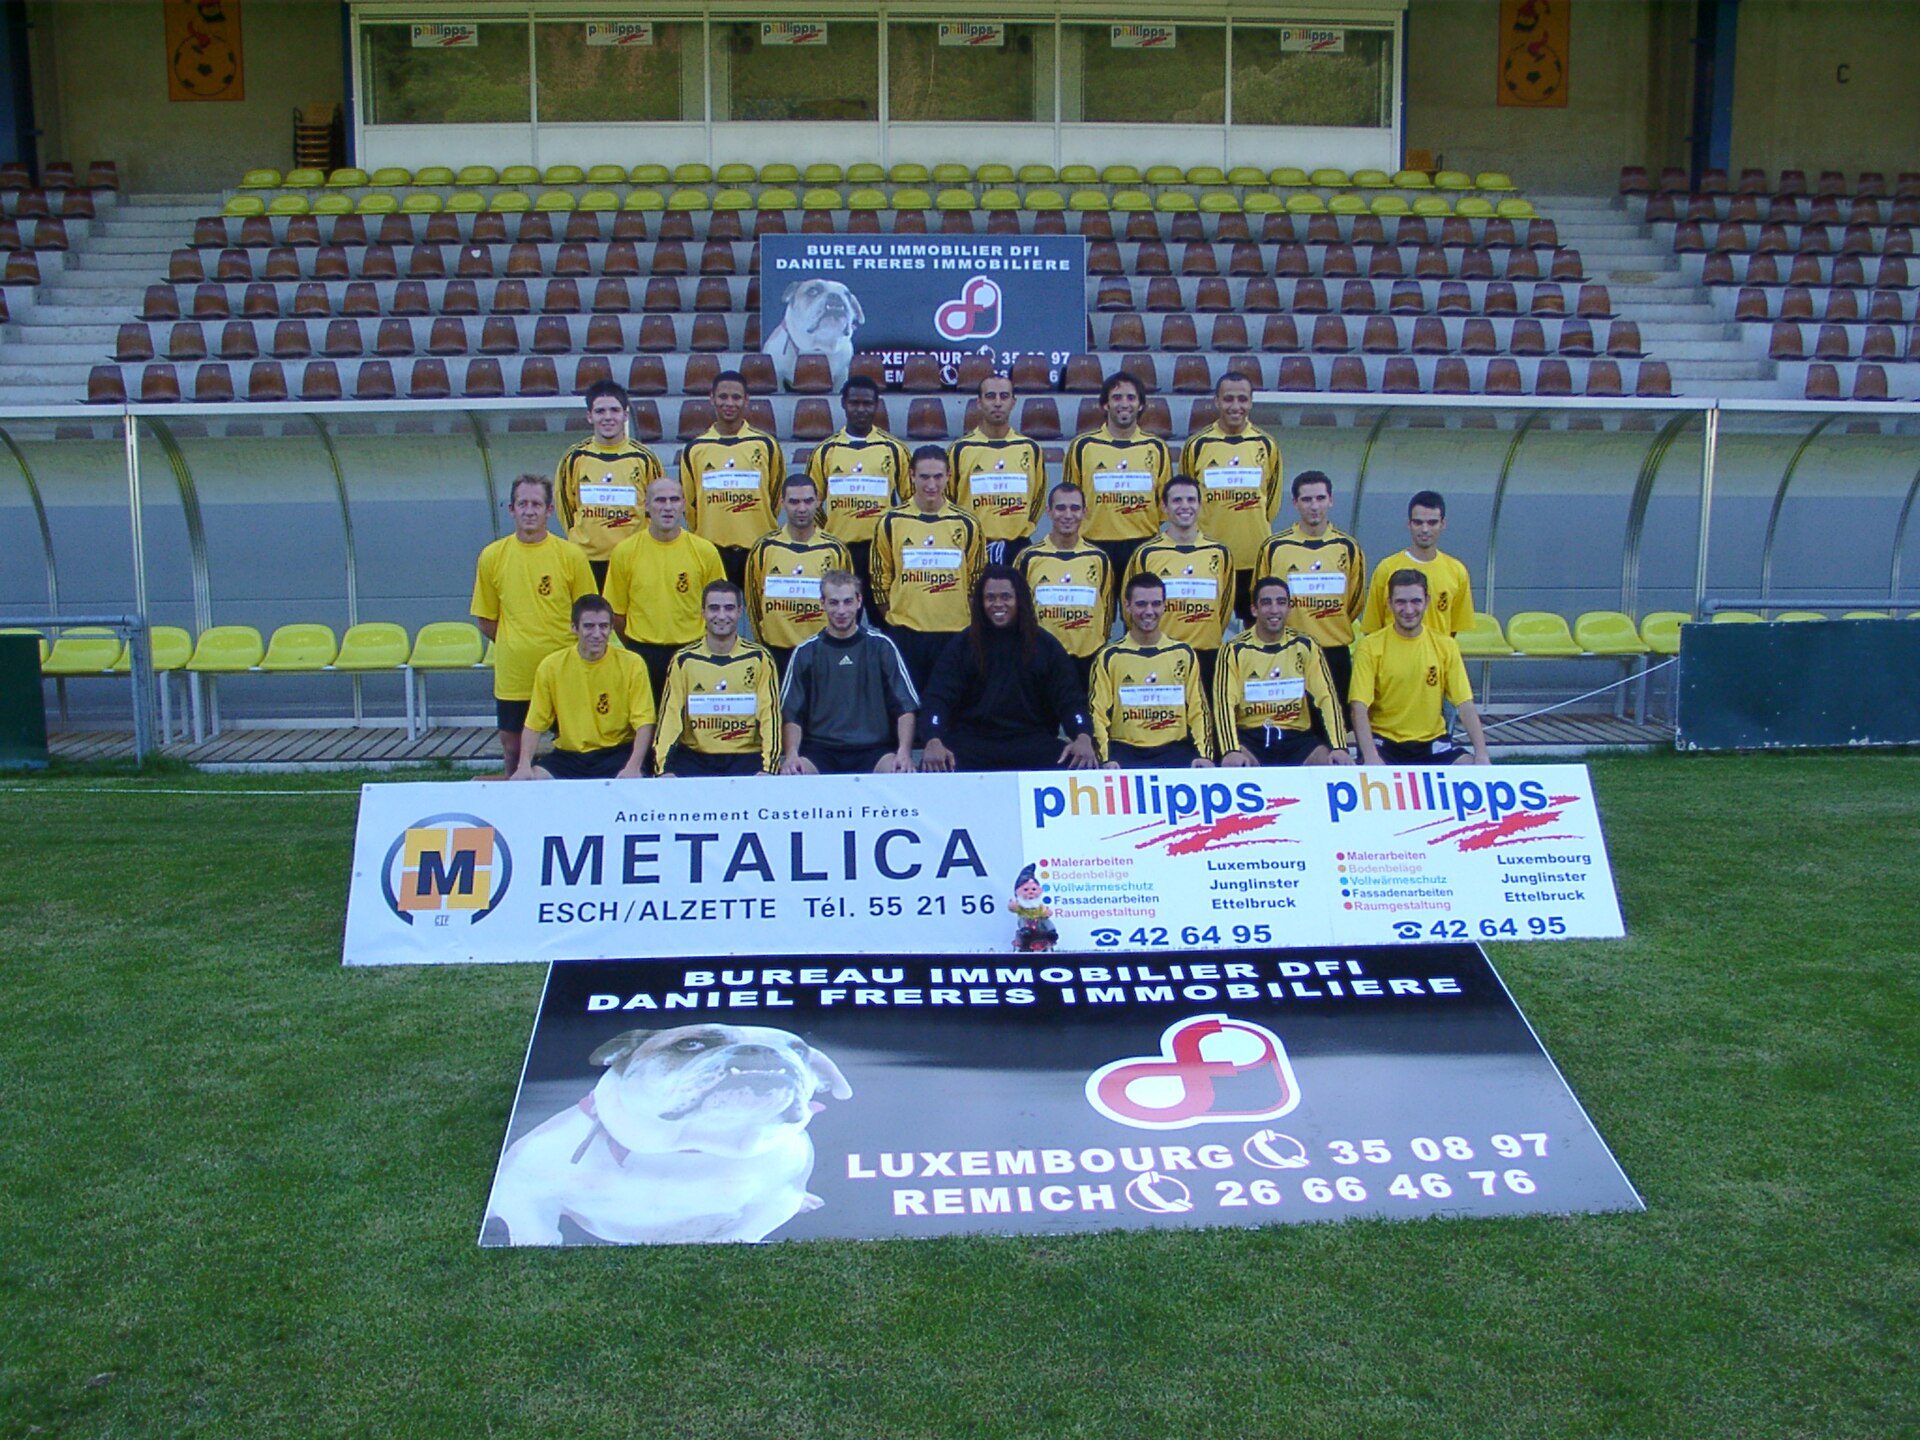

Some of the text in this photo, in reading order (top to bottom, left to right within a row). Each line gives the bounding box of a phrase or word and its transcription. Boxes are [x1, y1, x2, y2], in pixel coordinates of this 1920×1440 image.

[414, 24, 467, 38] phillipps
[589, 22, 642, 36] phillipps
[763, 22, 817, 36] phillipps
[941, 23, 993, 36] phillipps
[1113, 25, 1165, 38] phillipps
[1283, 29, 1334, 42] phillipps
[1837, 64, 1850, 84] C
[807, 244, 1039, 257] BUREAU IMMOBILIER DFI
[776, 258, 1070, 271] DANIEL FRERES IMMOBILIERE
[1051, 352, 1070, 365] 97
[902, 571, 954, 584] phillipps
[766, 600, 819, 613] phillipps
[1123, 709, 1174, 722] phillipps
[1034, 775, 1265, 828] phillipps
[1326, 772, 1548, 823] phillipps
[615, 806, 920, 822] Anciennement Castellani Frères
[541, 828, 988, 886] METALICA
[1051, 857, 1134, 867] Malerarbeiten
[1347, 850, 1426, 861] Malerarbeiten
[1497, 853, 1591, 865] Luxembourg
[1207, 859, 1306, 872] Luxembourg
[1349, 863, 1422, 875] Bodenbeläge
[416, 850, 476, 895] M
[1052, 870, 1129, 881] Bodenbeläge
[1501, 872, 1586, 885] Junglinster
[1054, 881, 1154, 892] Vollwärmeschutz
[1210, 878, 1300, 892] Junglinster
[1350, 875, 1447, 885] Vollwärmeschutz
[1054, 894, 1159, 905] Fassadenarbeiten
[1352, 888, 1453, 898] Fassadenarbeiten
[1505, 890, 1585, 902] Ettelbruck
[538, 894, 995, 924] ESCH/ALZETTE Tél. 55 21 56
[1212, 898, 1296, 910] Ettelbruck
[1354, 900, 1451, 912] Raumgestaltung
[1055, 906, 1156, 919] Raumgestaltung
[1430, 916, 1566, 938] 42 64 95
[1129, 924, 1272, 946] 42 64 95
[684, 960, 1363, 986] BUREAU IMMOBILIER DFI
[587, 977, 1462, 1011] DANIEL FRERES IMMOBILIERE
[847, 1132, 1548, 1179] LUXEMBOURG 35 08 97
[893, 1168, 1536, 1216] REMICH 26 66 46 76
